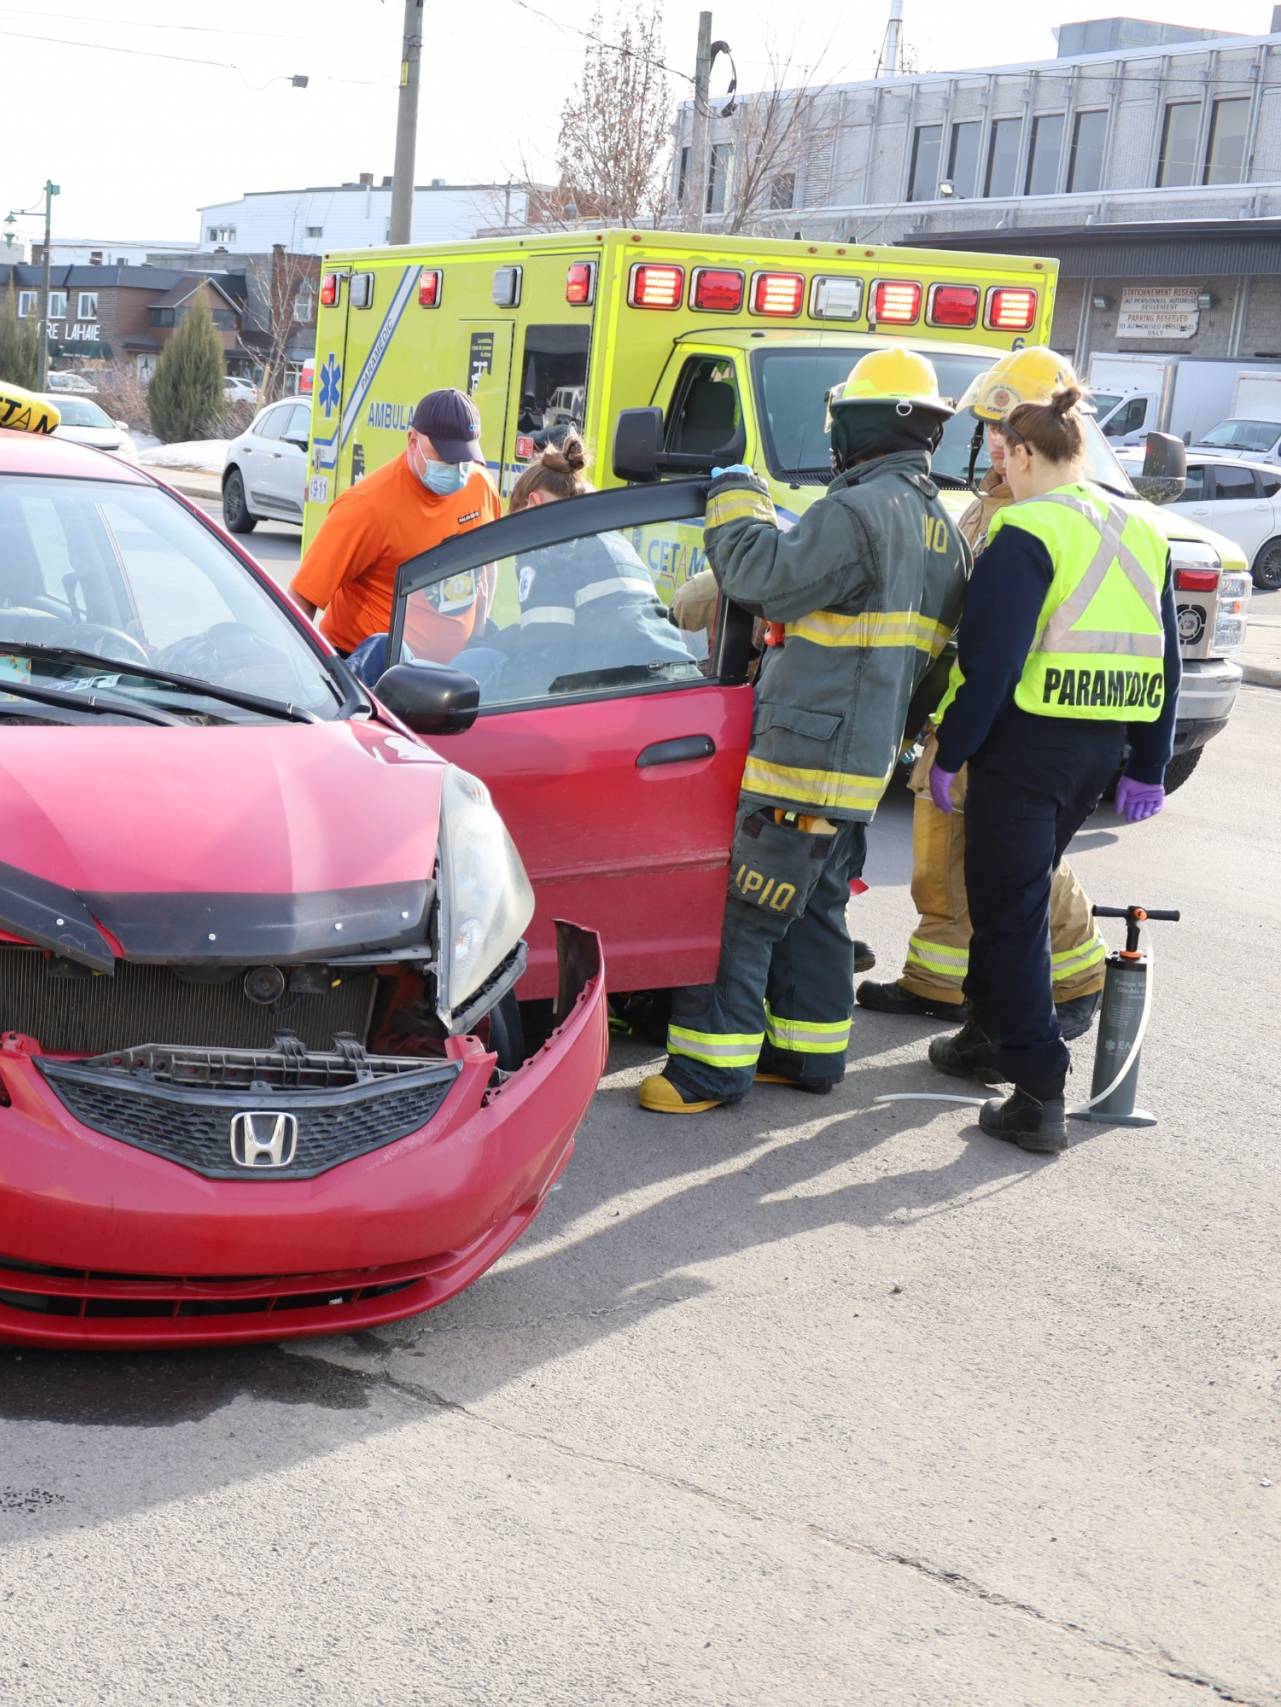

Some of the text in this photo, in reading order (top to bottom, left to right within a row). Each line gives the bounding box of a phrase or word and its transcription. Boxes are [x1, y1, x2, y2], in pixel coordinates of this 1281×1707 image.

[1127, 314, 1154, 323] PARKING
[64, 323, 100, 341] LAHAIE
[368, 402, 417, 430] AMBULA
